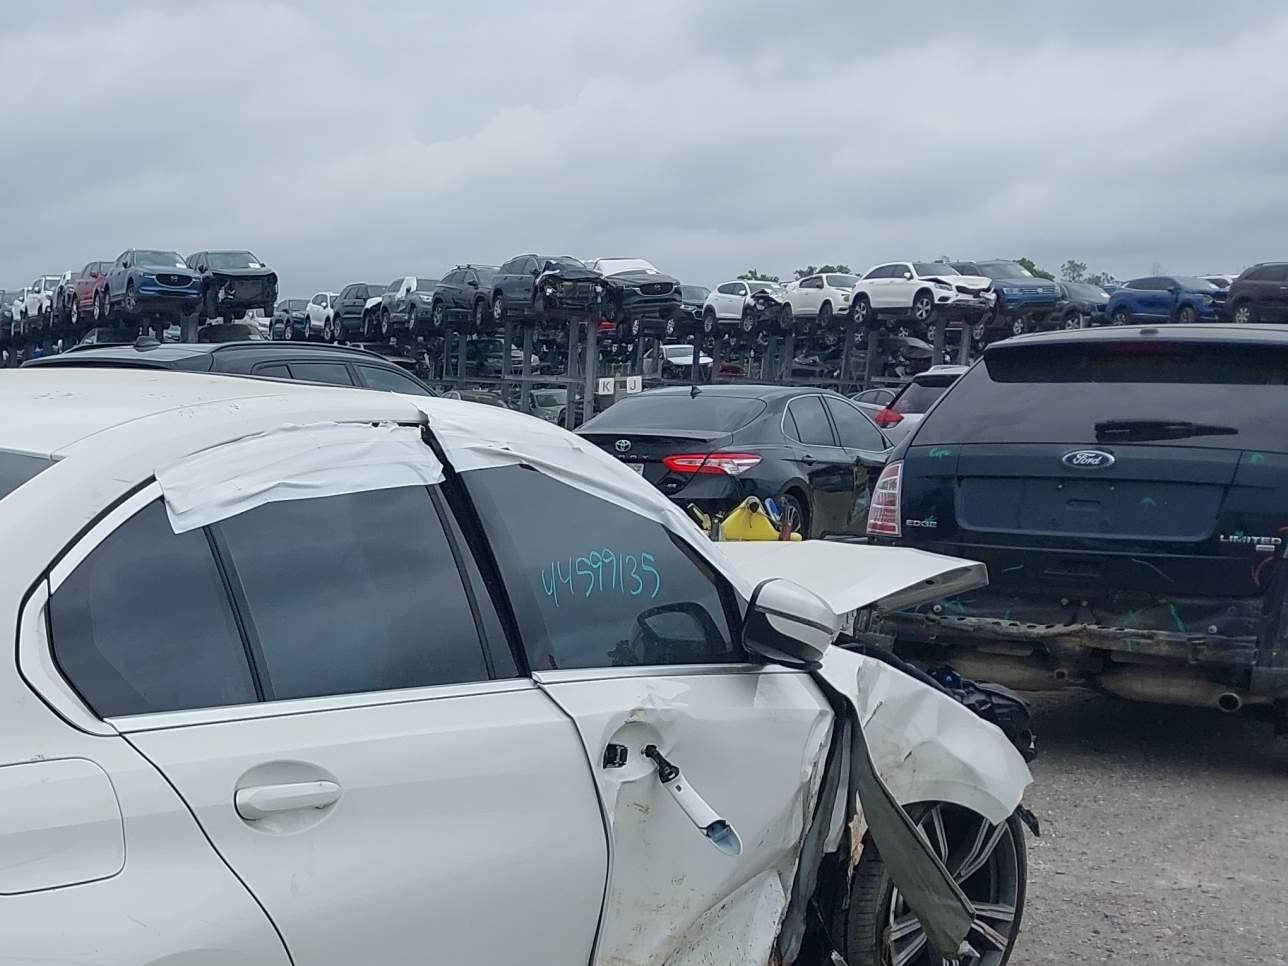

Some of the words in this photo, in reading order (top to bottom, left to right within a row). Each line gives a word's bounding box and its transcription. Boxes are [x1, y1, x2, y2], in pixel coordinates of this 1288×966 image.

[602, 381, 610, 392] K
[630, 379, 637, 391] J
[1072, 452, 1103, 465] Ford
[906, 519, 937, 528] EDGE
[1219, 534, 1283, 545] LIMITED
[541, 548, 661, 608] 44599135
